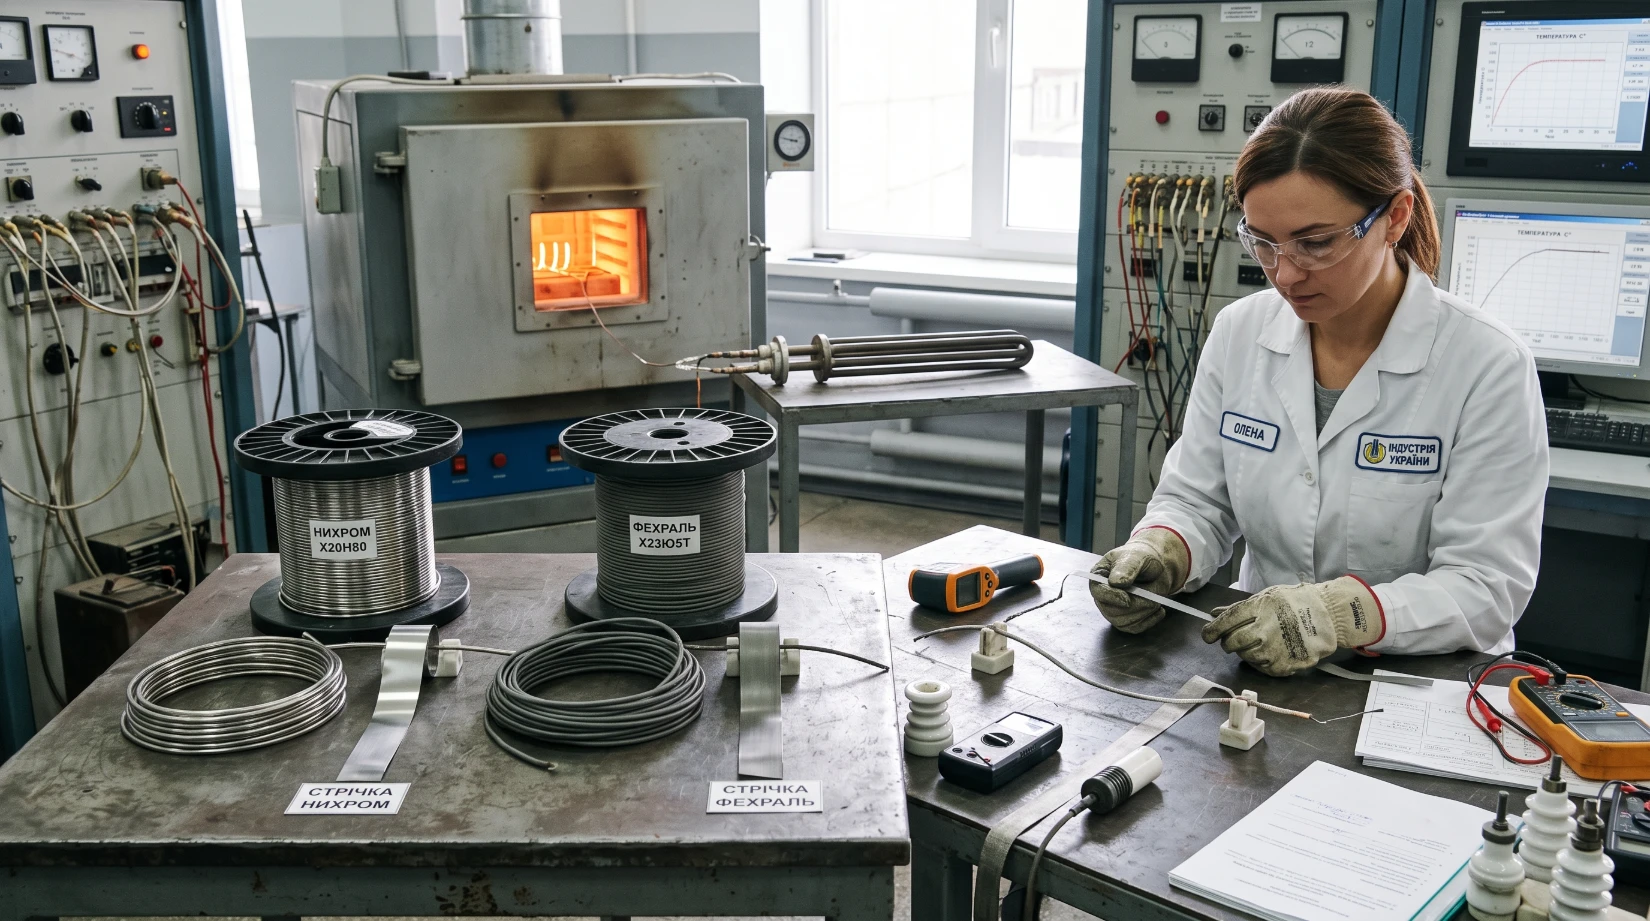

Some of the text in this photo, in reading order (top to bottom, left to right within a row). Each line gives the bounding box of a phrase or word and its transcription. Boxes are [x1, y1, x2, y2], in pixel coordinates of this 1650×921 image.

[1517, 229, 1561, 237] ТЕМПЕРАТУРА
[1234, 422, 1264, 441] ОЛЕНА
[1388, 443, 1436, 454] ІНДУСТРІЯ
[1389, 454, 1430, 466] УКРАЇНИ
[313, 527, 371, 538] НИХРОМ
[633, 522, 696, 533] ФЕХРАЛЬ
[319, 541, 367, 552] Х20Н80
[639, 537, 691, 549] Х23Ю5Т
[308, 787, 393, 796] СТРІЧКА
[723, 785, 808, 794] СТРІЧКА
[300, 800, 391, 809] НИХРОМ
[716, 797, 815, 807] ФЕХРАЛЬ
